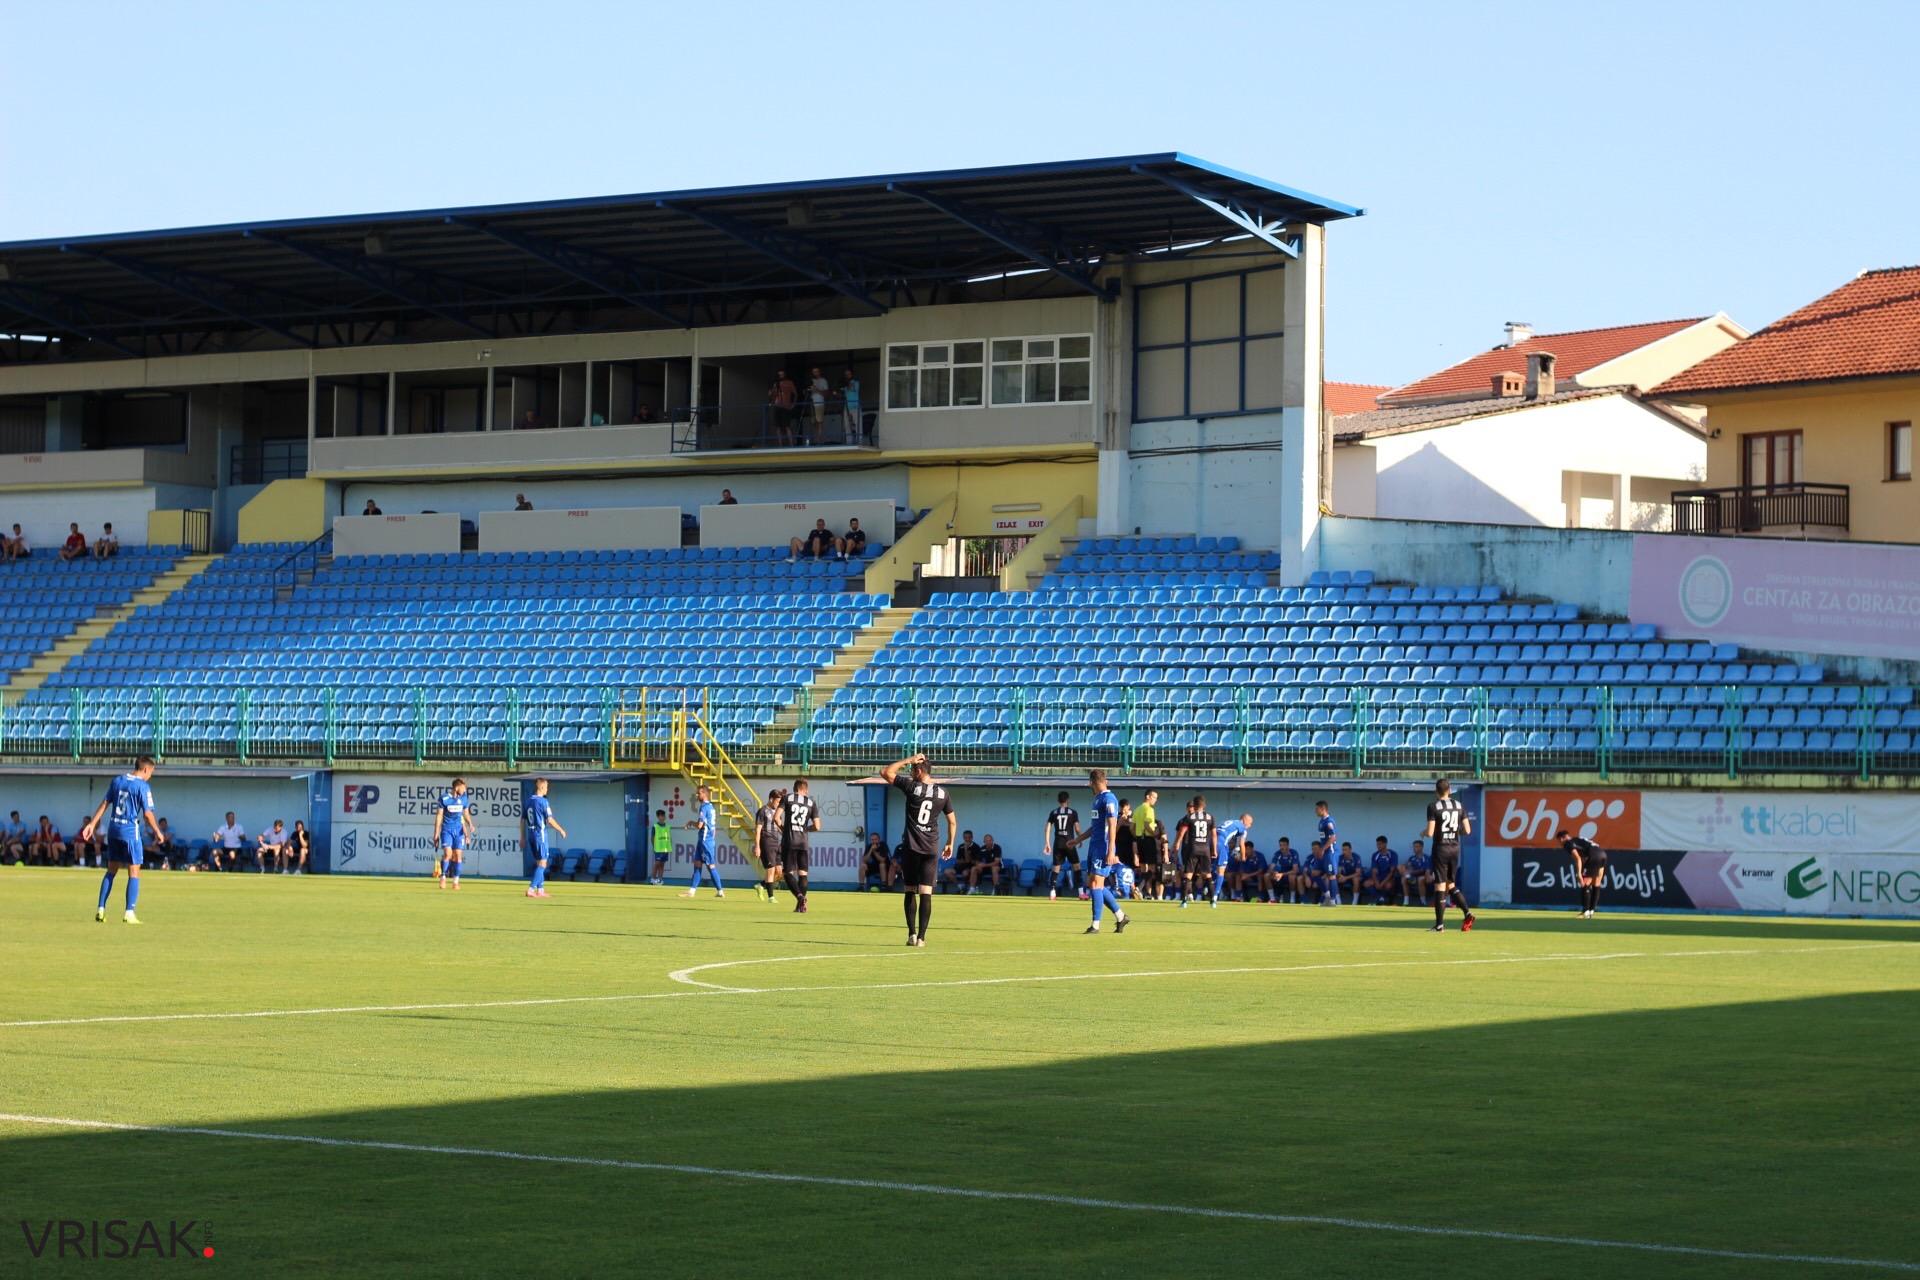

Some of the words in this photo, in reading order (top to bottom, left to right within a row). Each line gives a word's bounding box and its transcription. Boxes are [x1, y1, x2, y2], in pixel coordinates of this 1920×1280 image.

[1028, 520, 1044, 528] EXIT
[1743, 587, 1811, 609] CENTAR
[1818, 591, 1841, 611] ZA
[1847, 593, 1920, 616] OBRAZO
[399, 785, 519, 801] ELEKTPRIVRE
[398, 802, 416, 815] HZ
[491, 803, 522, 817] BOS
[791, 804, 809, 826] 23
[918, 800, 933, 825] 6
[1500, 799, 1559, 840] bh
[1740, 804, 1857, 836] ttkabeli
[1056, 815, 1068, 830] 17
[1194, 820, 1207, 837] 13
[1441, 811, 1459, 832] 24
[1523, 861, 1556, 888] Za
[1610, 863, 1665, 898] bolji!
[1742, 868, 1774, 878] kramar
